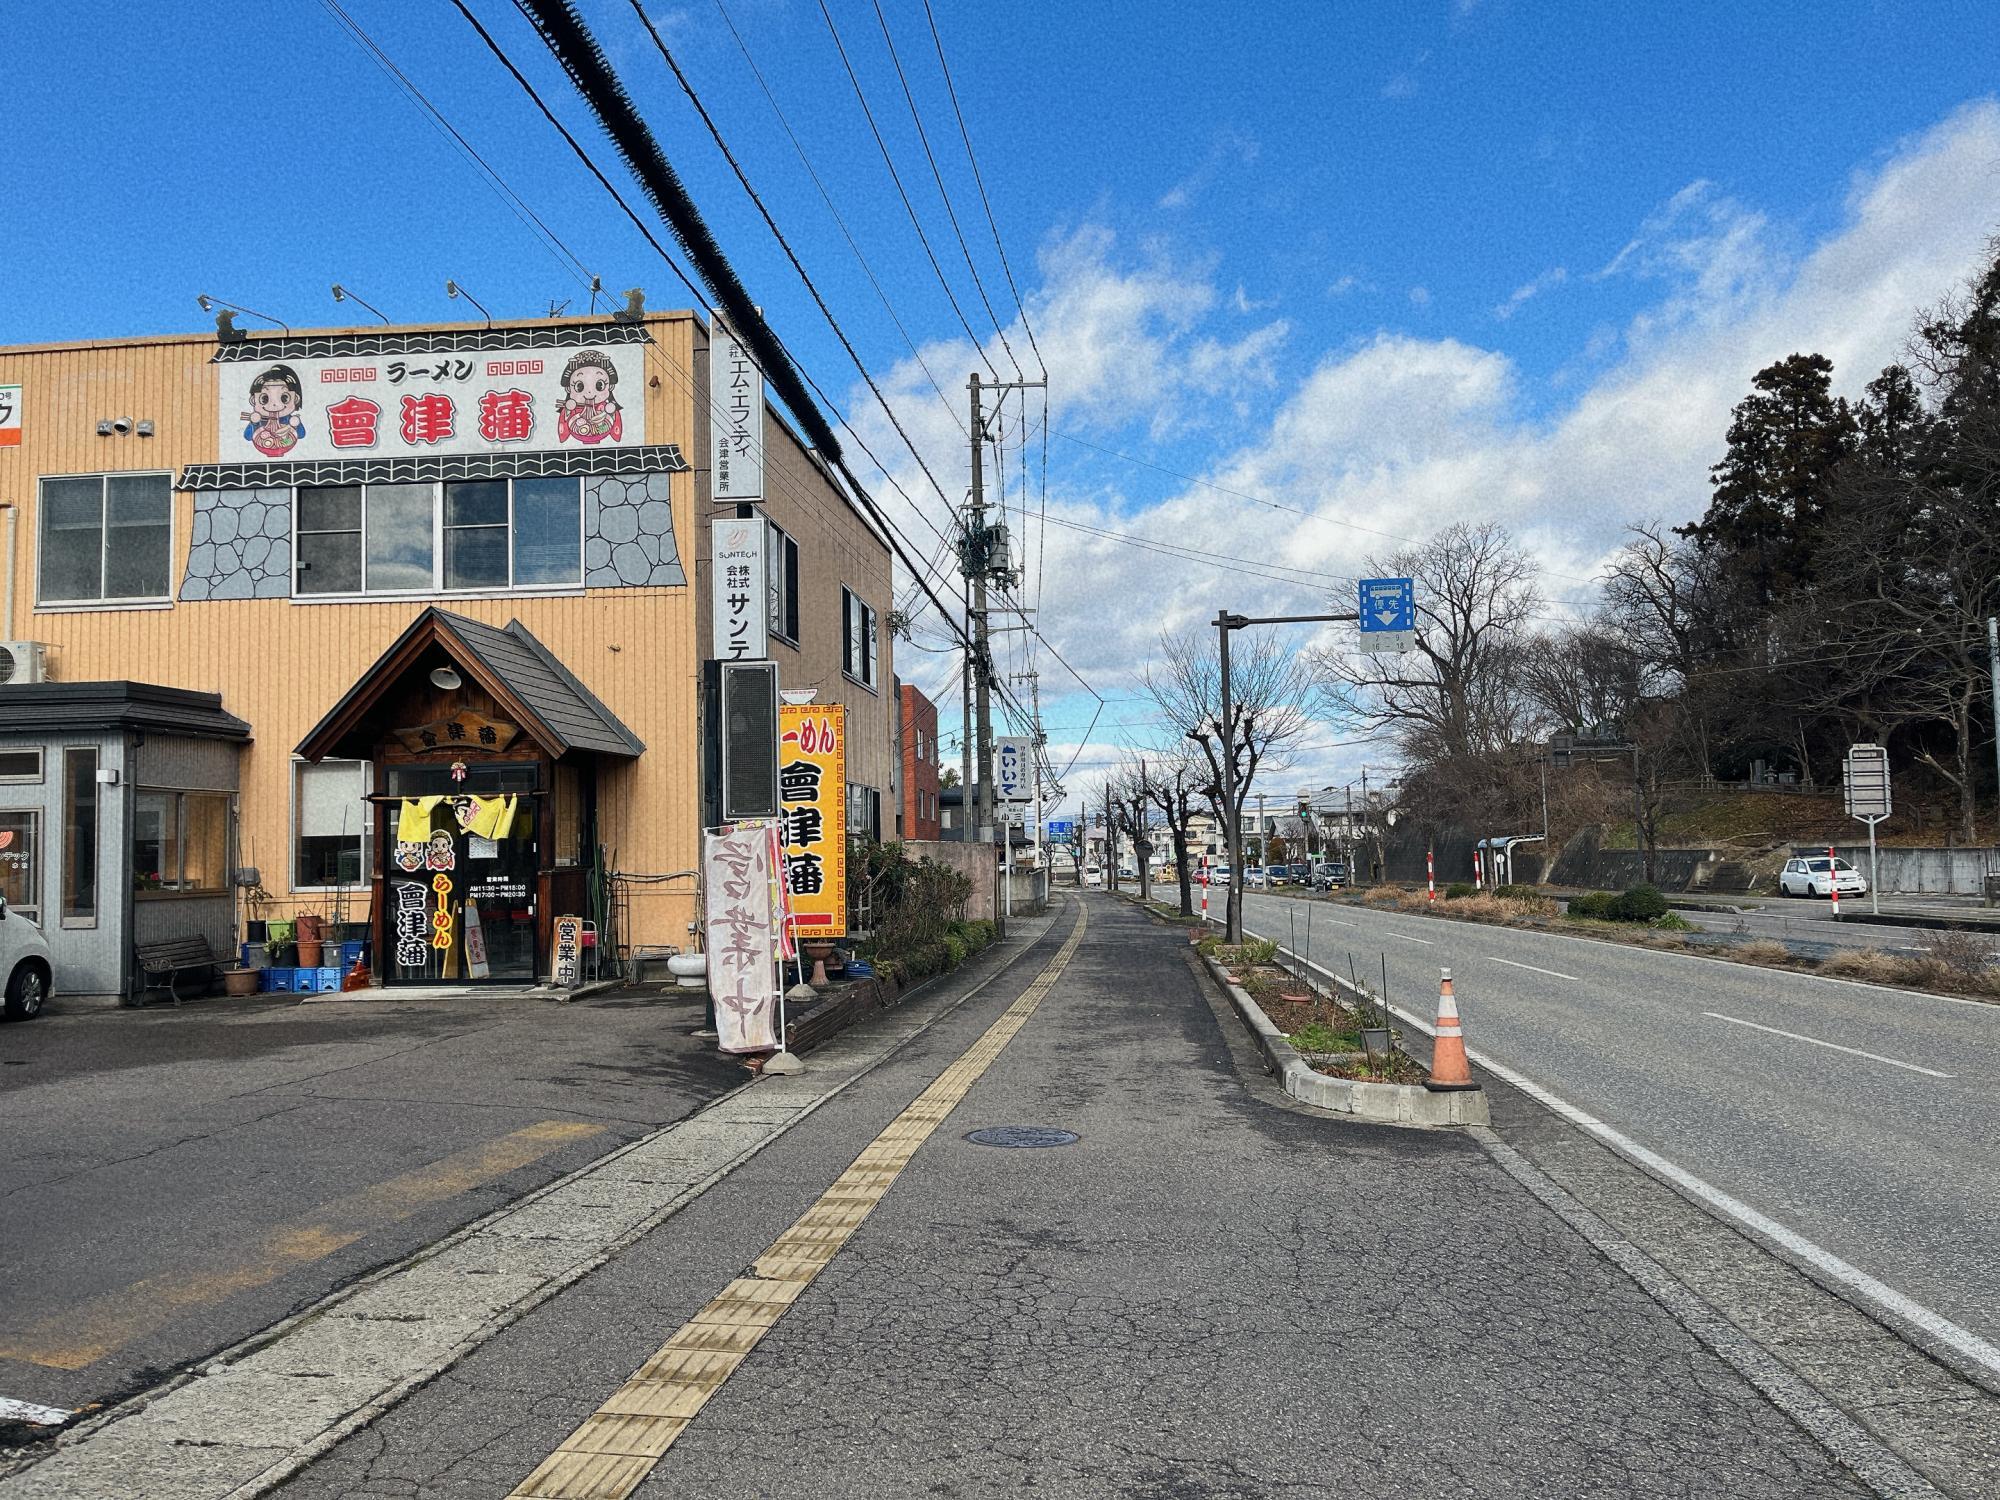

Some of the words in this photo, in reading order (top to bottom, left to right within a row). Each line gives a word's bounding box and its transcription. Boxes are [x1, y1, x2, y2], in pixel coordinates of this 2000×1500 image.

[386, 358, 474, 384] ラーメン
[326, 388, 535, 448] 會津藩
[719, 438, 730, 492] 会津営業所
[727, 593, 750, 659] サンテ
[1375, 599, 1400, 610] 優先
[1002, 756, 1018, 795] いいで
[397, 882, 428, 966] 會津藩
[432, 873, 453, 949] らーめん
[558, 921, 576, 983] 営業中
